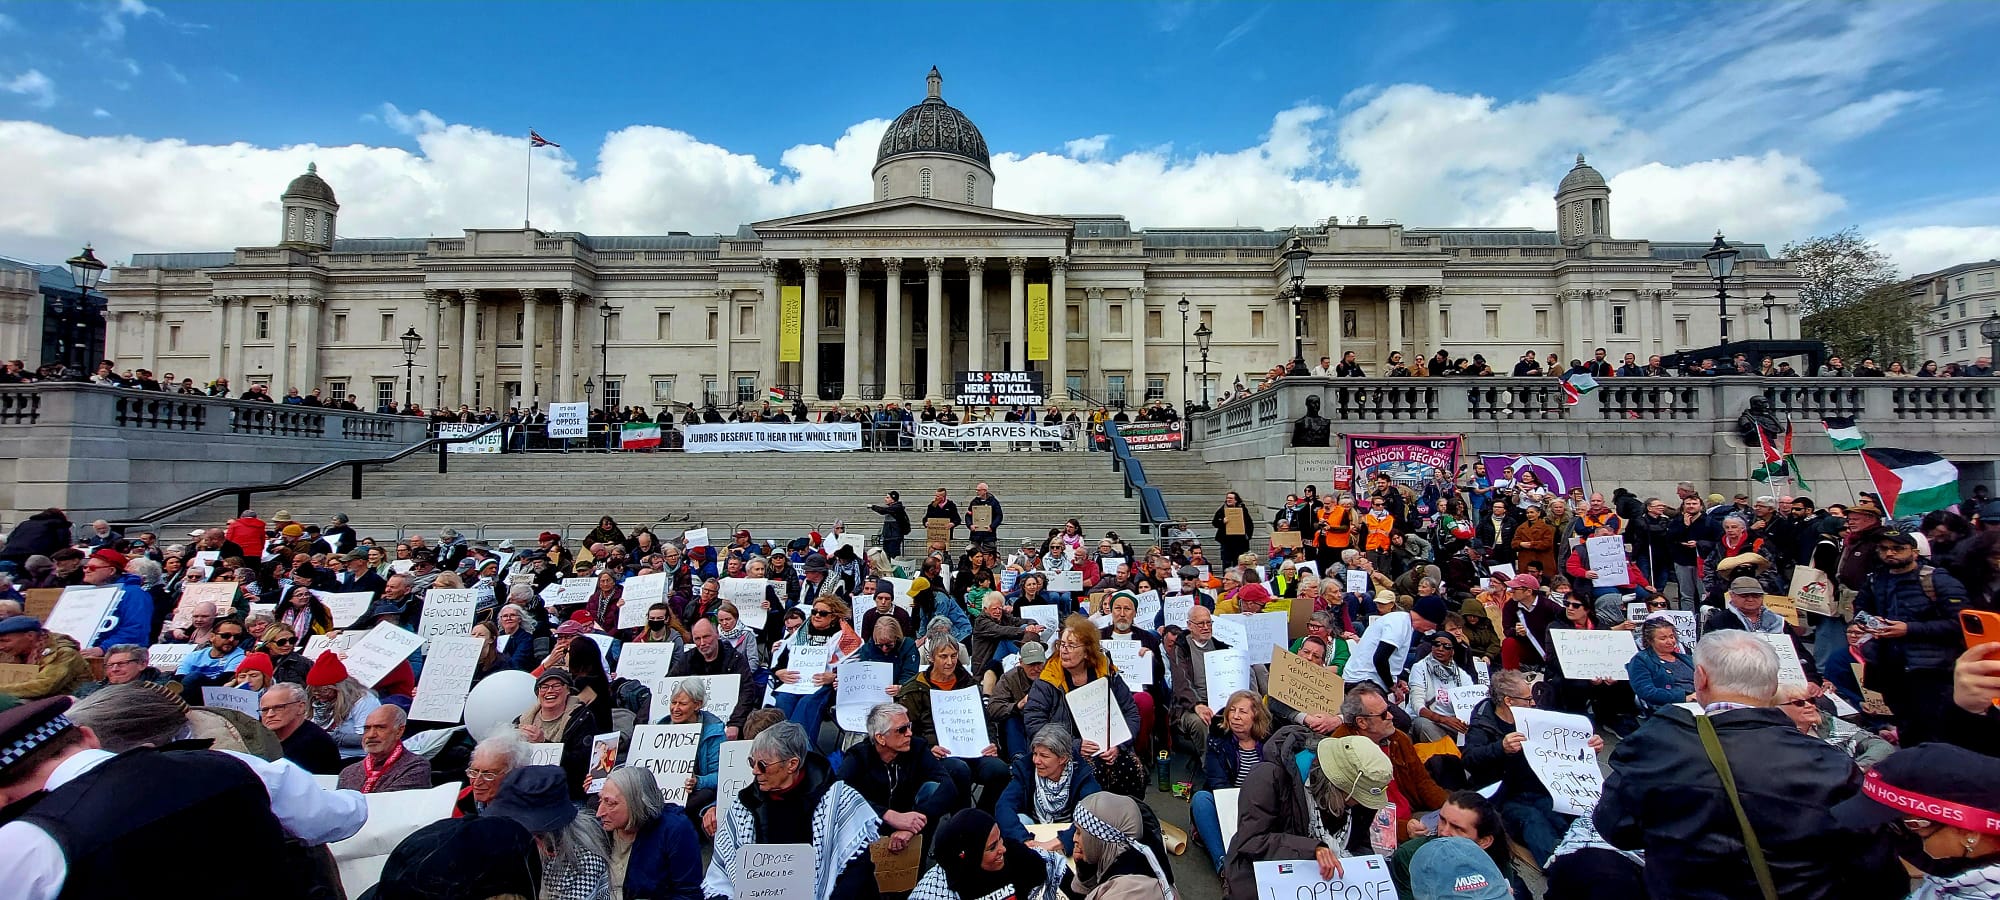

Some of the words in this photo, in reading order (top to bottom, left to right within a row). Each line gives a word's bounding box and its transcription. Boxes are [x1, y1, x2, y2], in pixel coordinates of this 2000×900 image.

[992, 373, 1031, 382] ISRAEL
[965, 384, 990, 393] HERE
[993, 384, 1005, 393] TO
[1008, 384, 1034, 393] KILL
[957, 395, 990, 404] STEAL
[998, 395, 1042, 405] CONQUER
[441, 423, 474, 432] DEFEND
[917, 425, 964, 438] ISRAEL
[967, 427, 1026, 437] STARVES
[1030, 427, 1060, 438] KIDS
[689, 432, 718, 443] JURORS
[720, 432, 753, 441] DESERVE
[756, 432, 765, 441] TO
[768, 432, 787, 441] HEAR
[790, 431, 803, 441] THE
[806, 431, 831, 441] WHOLE
[834, 431, 857, 441] TRUTH
[1357, 447, 1389, 460] University
[1407, 445, 1429, 453] College
[1356, 451, 1404, 471] LONDON
[1410, 451, 1449, 468] REGION
[429, 593, 433, 605] I
[437, 593, 473, 603] OPPOSE
[424, 608, 468, 617] GENOCIDE
[430, 623, 471, 636] SUPPORT
[440, 643, 481, 659] OPPOSE
[1106, 641, 1136, 650] OPPOSE
[1282, 651, 1287, 659] I
[1294, 657, 1329, 679] OPPOSE
[431, 678, 472, 690] SUPPORT
[843, 674, 878, 683] OPPOSE
[1287, 664, 1333, 691] GENOCIDE
[845, 684, 882, 695] GENOCIDE
[1290, 678, 1334, 705] SUPPORT
[1454, 692, 1459, 700] I
[944, 694, 973, 702] OPPOSE
[1277, 691, 1308, 709] ACTION
[1288, 687, 1336, 714] PALESTINE
[1523, 718, 1530, 740] I
[638, 732, 645, 751] I
[653, 733, 701, 749] OPPOSE
[728, 750, 735, 767] I
[1535, 747, 1594, 764] Genocide
[1878, 787, 1965, 822] HOSTAGES
[743, 850, 748, 870] I
[752, 852, 795, 868] OPPOSE
[746, 870, 795, 880] GENOCIDE
[1297, 879, 1391, 900] OPPOSE
